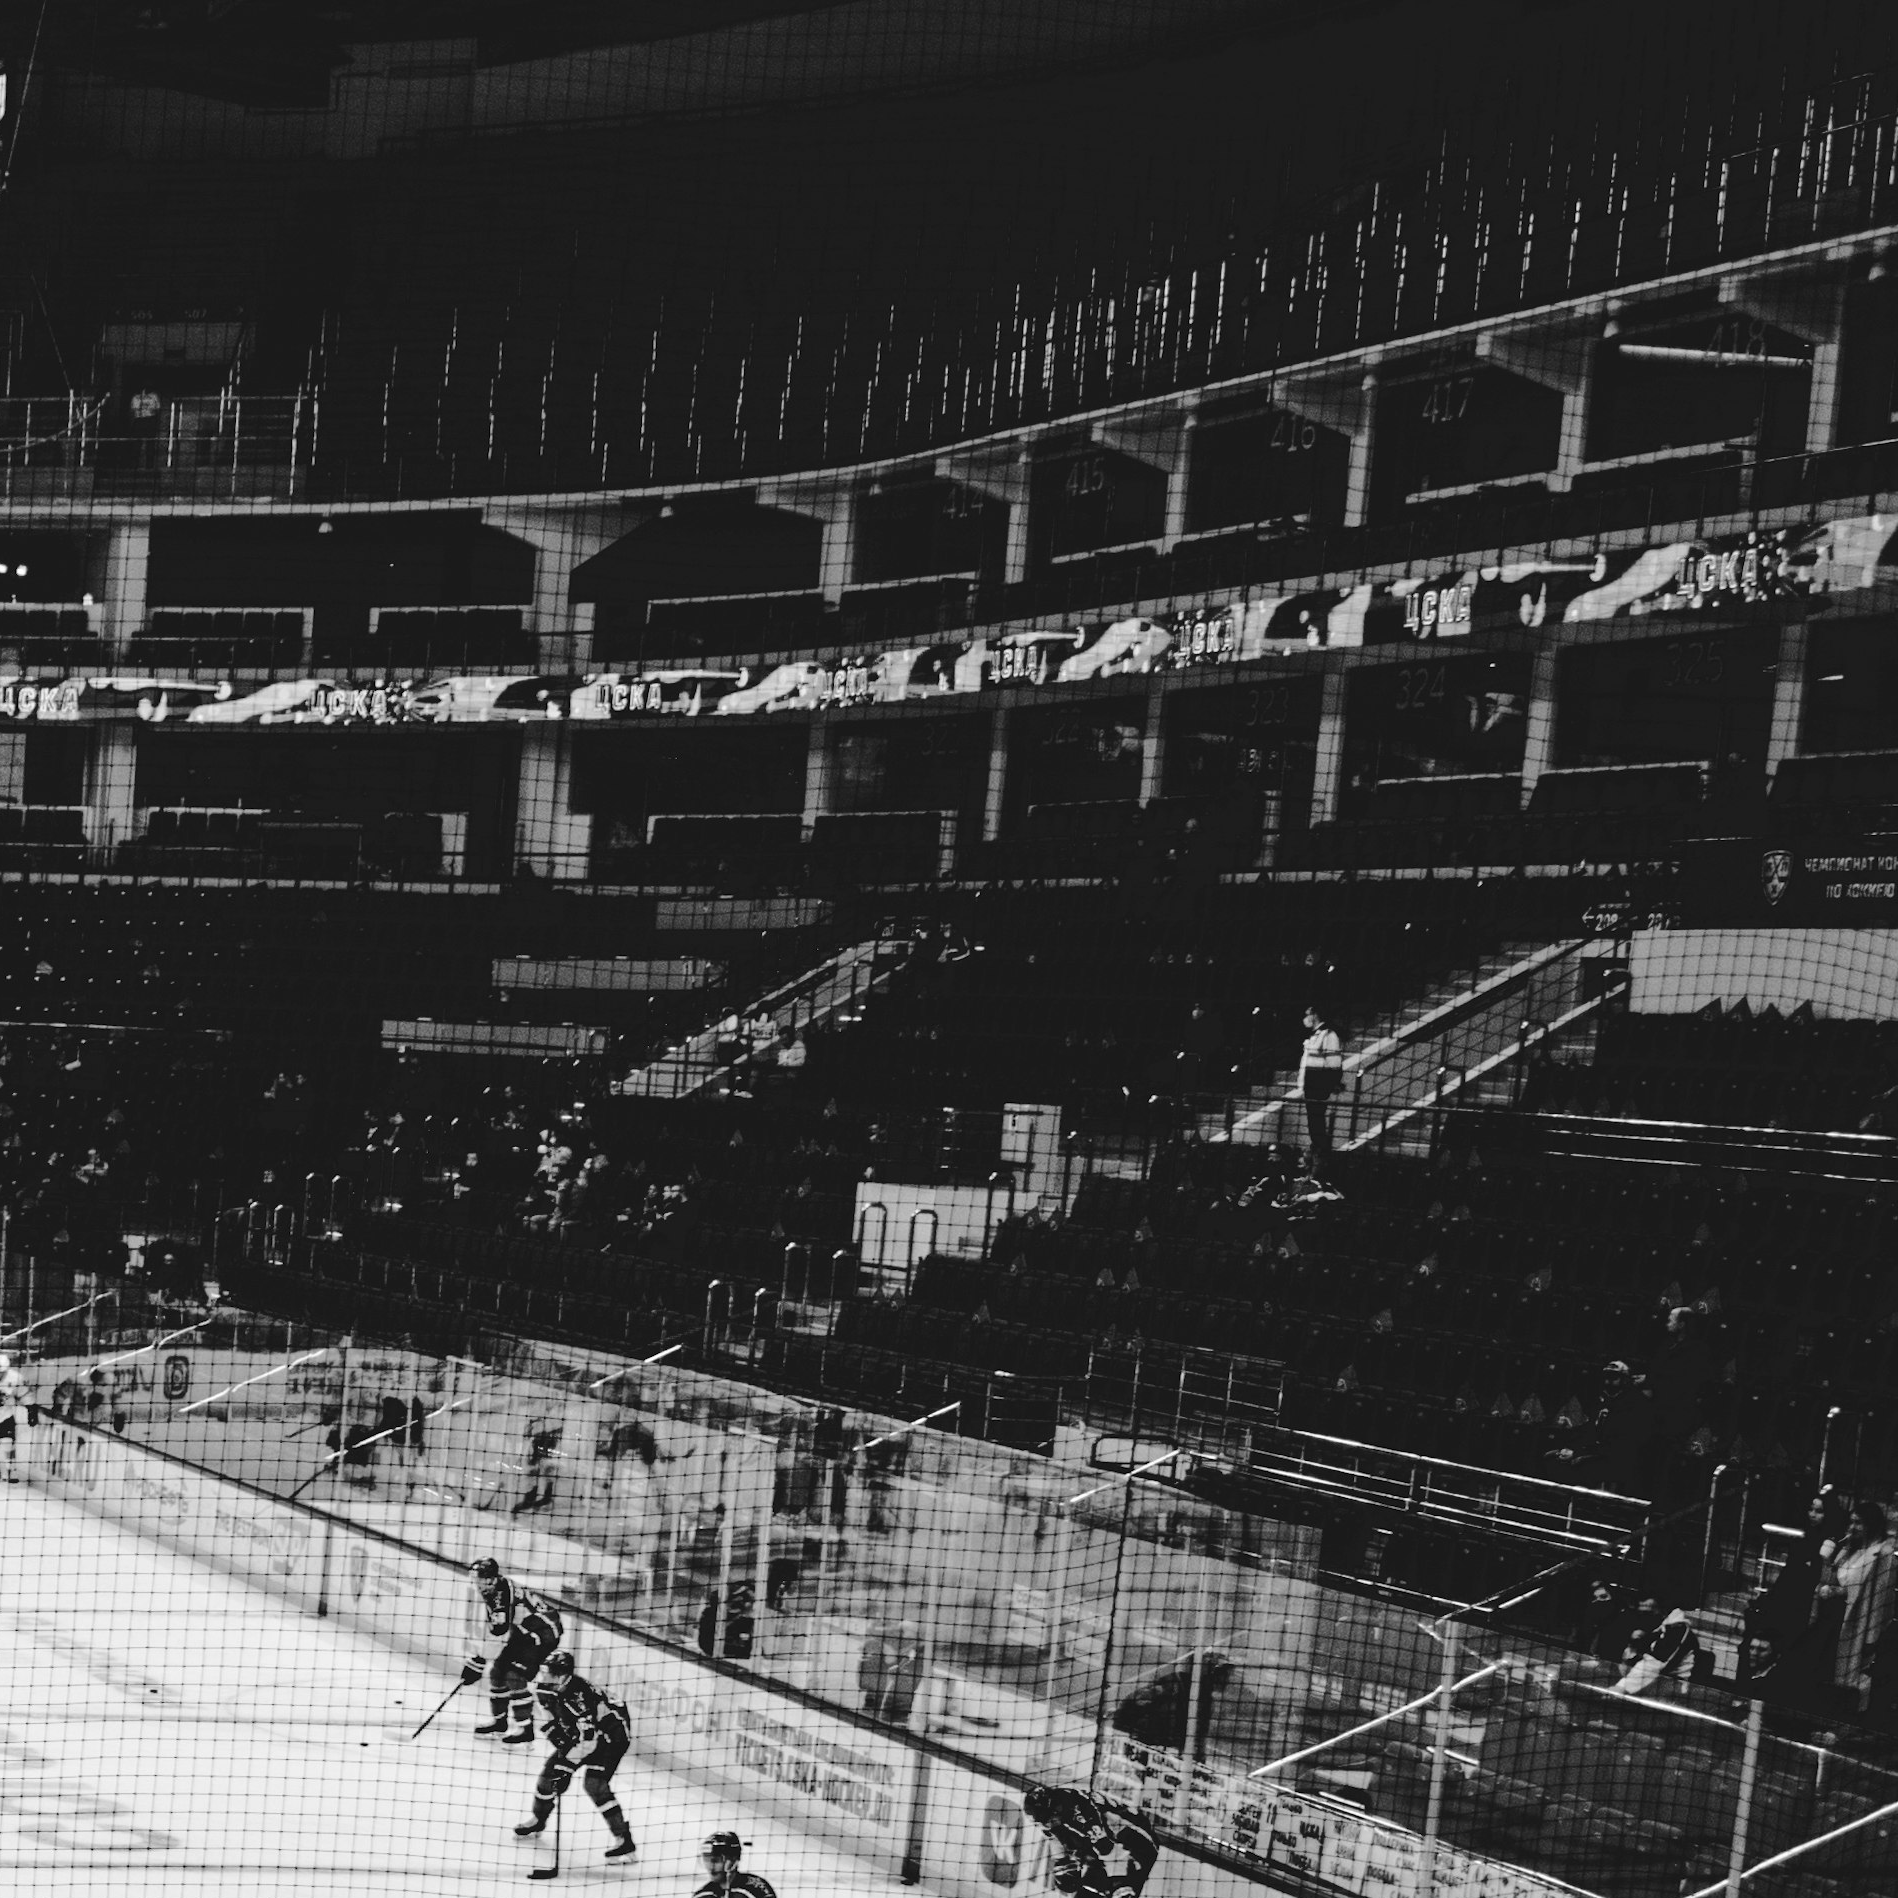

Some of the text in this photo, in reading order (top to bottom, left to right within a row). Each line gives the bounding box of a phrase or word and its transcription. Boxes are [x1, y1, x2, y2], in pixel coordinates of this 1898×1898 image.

[1422, 377, 1474, 424] 417
[1066, 456, 1105, 495] 415
[1678, 550, 1757, 597] ЦСКА
[1403, 586, 1471, 630] ЦСКА
[310, 690, 386, 719] ЦСКА
[594, 682, 661, 712] ЦСКА
[1395, 664, 1445, 710] 324
[1826, 883, 1843, 898] ПО
